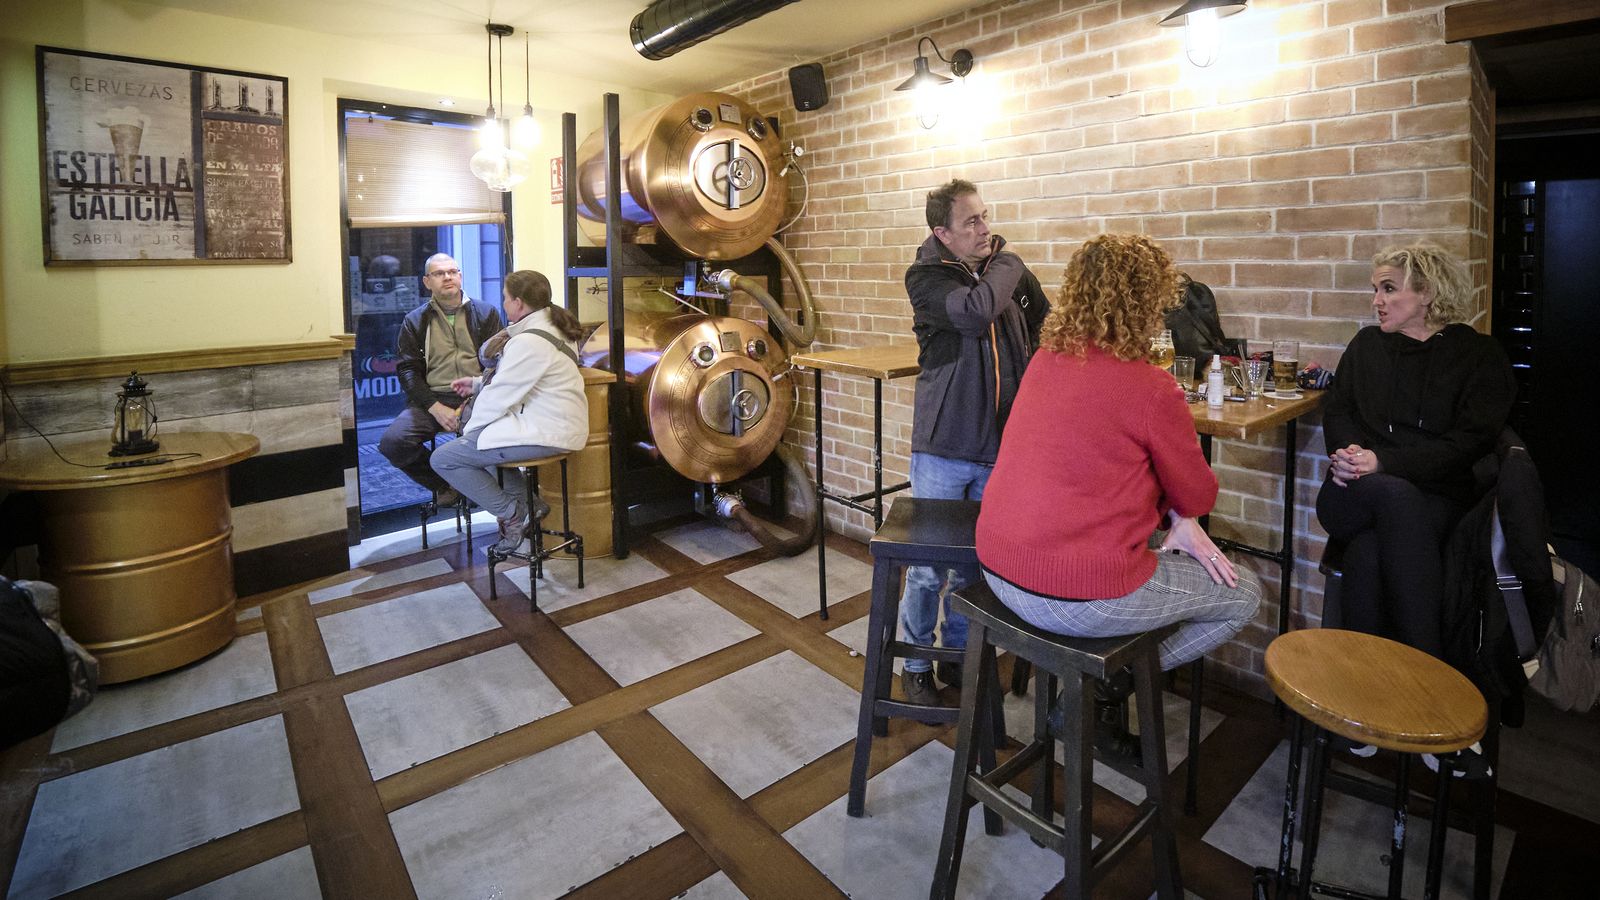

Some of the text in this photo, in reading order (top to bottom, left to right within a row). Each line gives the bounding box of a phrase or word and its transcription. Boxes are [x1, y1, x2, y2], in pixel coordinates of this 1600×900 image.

[70, 76, 174, 101] CERVEZAS
[52, 149, 193, 192] ESTRELLA
[69, 185, 180, 222] GALICIA
